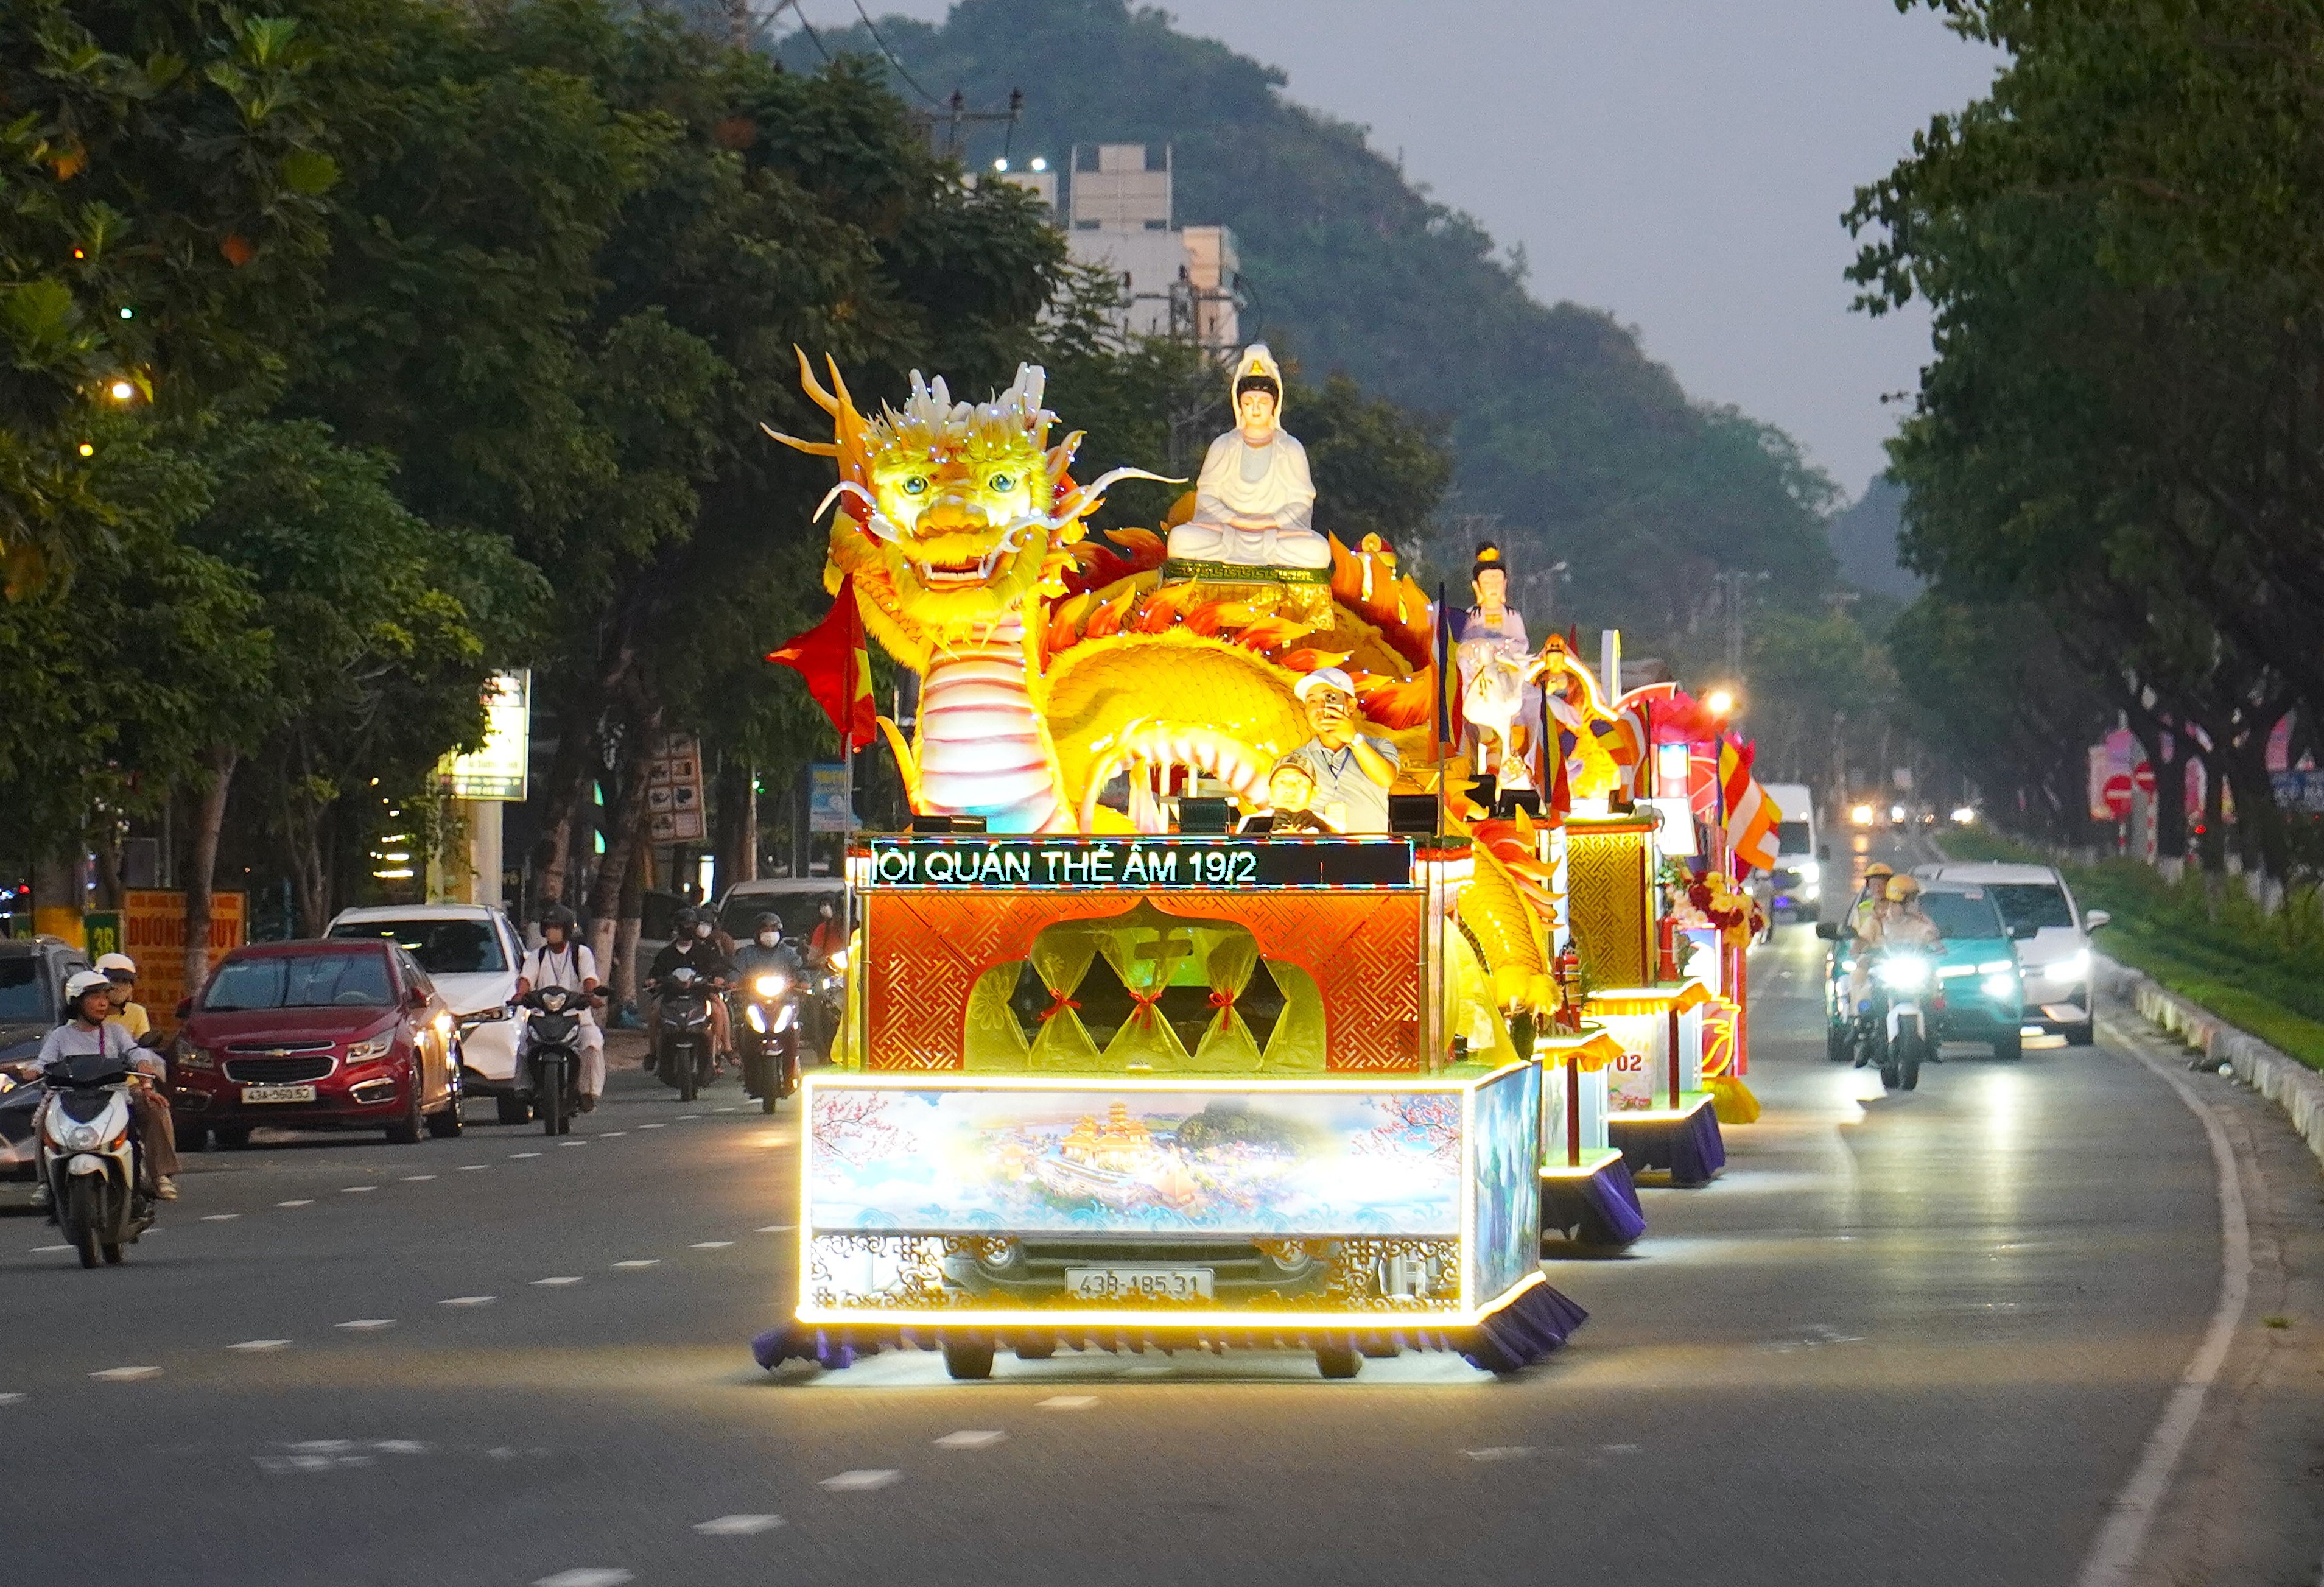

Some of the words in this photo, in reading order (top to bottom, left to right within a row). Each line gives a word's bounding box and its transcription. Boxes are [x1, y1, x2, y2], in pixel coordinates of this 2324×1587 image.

[925, 844, 1030, 882] QUÁN
[1122, 843, 1176, 882] ÂM
[1188, 851, 1257, 882] 19/2
[1616, 1054, 1642, 1072] 02
